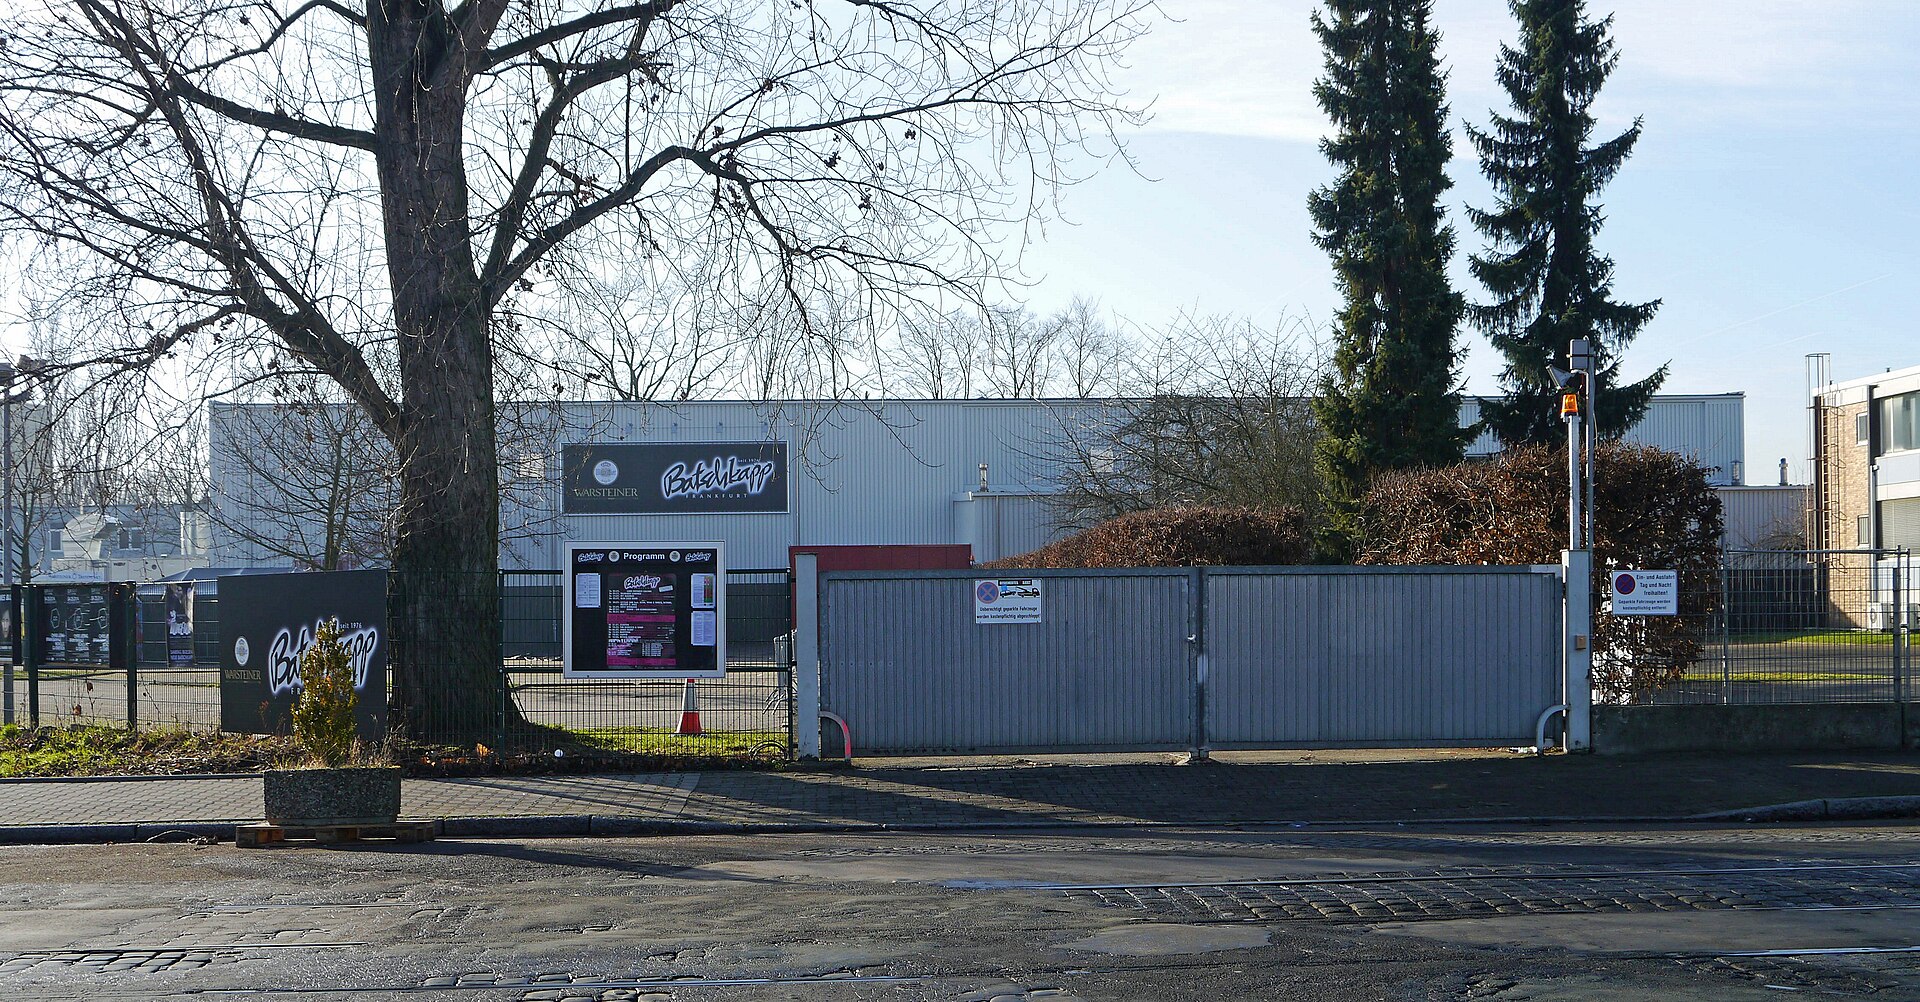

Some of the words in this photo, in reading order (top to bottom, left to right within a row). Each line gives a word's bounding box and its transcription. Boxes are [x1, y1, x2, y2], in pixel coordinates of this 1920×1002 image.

[662, 456, 774, 499] Batschkapp
[574, 487, 638, 497] WARSTEINER
[623, 552, 665, 562] Programm
[224, 669, 262, 680] WARSTEINER
